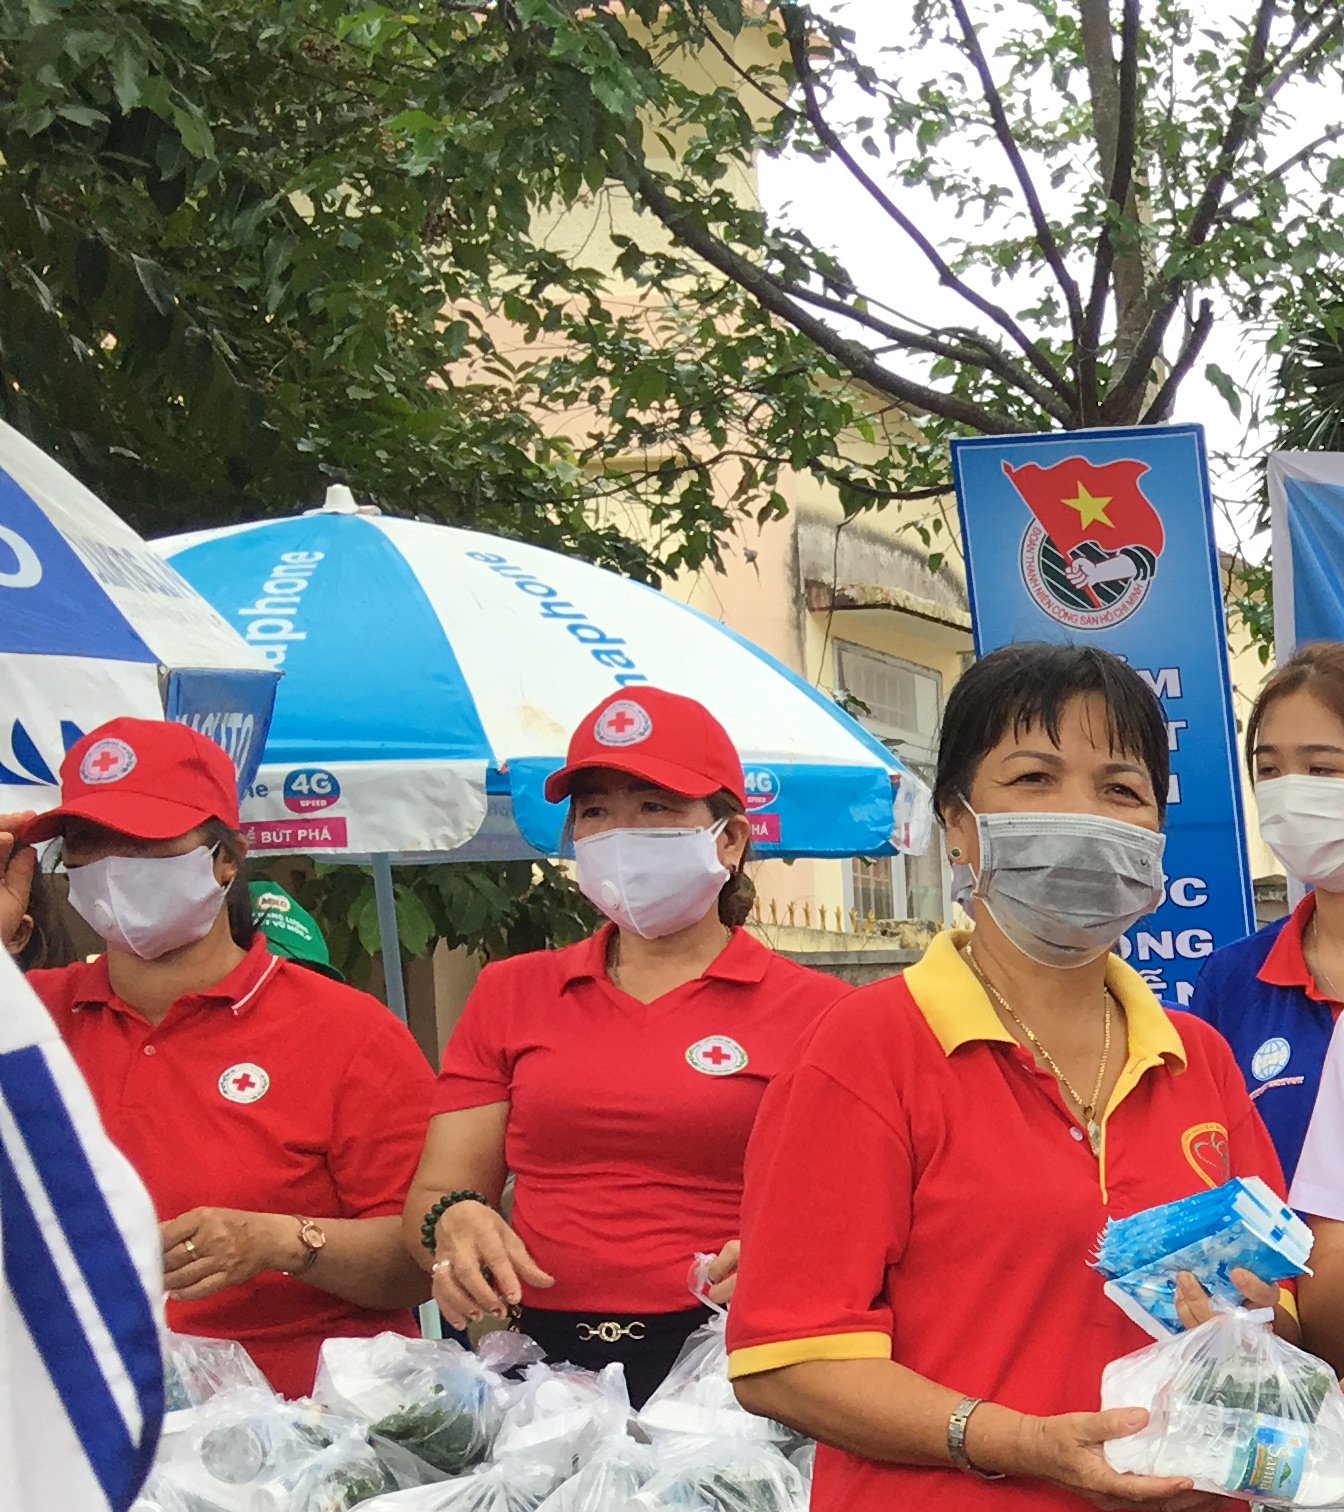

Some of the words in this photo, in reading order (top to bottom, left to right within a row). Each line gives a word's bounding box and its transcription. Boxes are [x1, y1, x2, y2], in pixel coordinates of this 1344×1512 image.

[1127, 583, 1145, 610] MINH
[238, 550, 326, 672] aphone
[290, 773, 332, 796] 4G
[751, 823, 769, 837] HÁ
